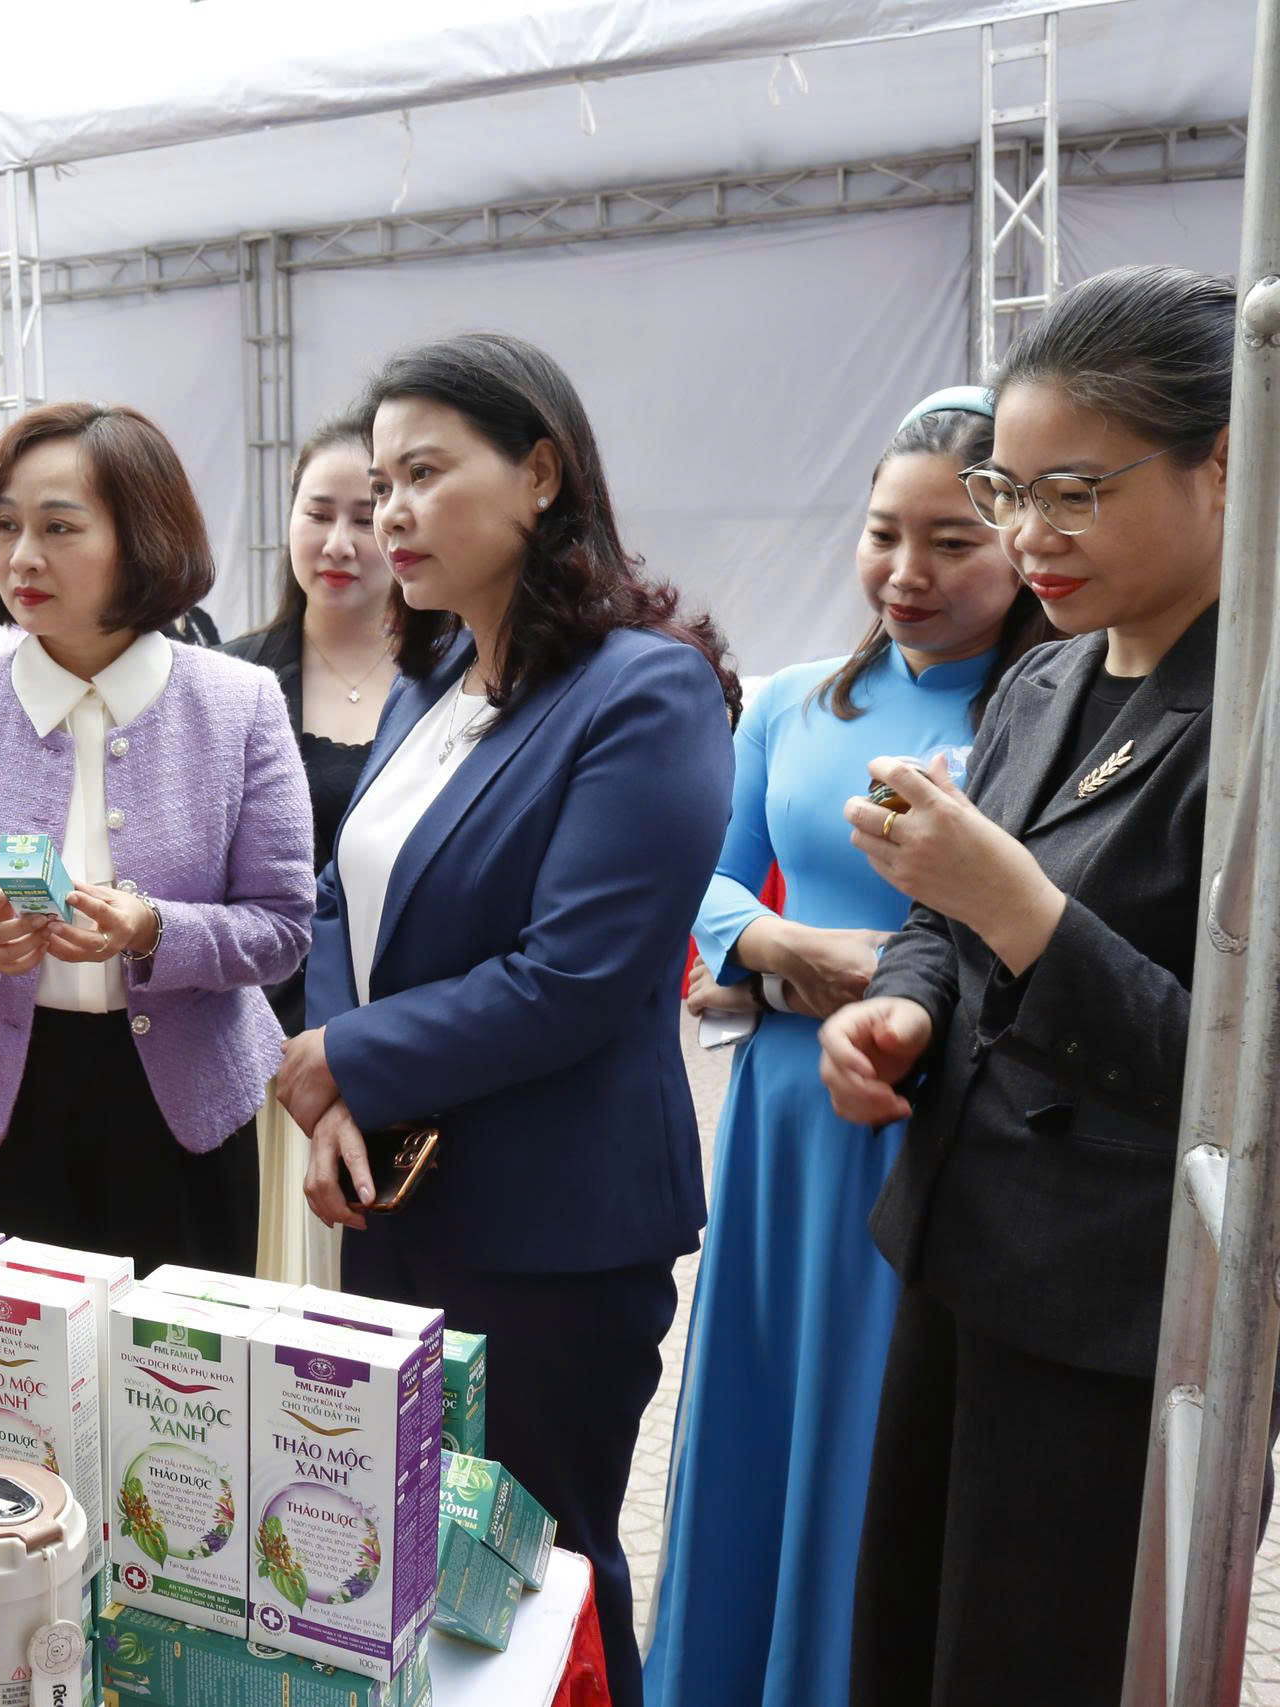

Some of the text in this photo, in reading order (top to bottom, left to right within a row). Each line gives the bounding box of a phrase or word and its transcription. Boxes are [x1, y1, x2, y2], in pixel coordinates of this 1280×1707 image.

[4, 1347, 16, 1356] EM
[24, 1343, 39, 1351] SINH
[154, 1345, 169, 1355] FML
[148, 1359, 169, 1370] DỊCH
[172, 1362, 188, 1375] RỬA
[191, 1368, 208, 1379] PHỤ
[211, 1372, 234, 1383] KHOA
[9, 1376, 47, 1397] MỘC
[295, 1381, 312, 1392] FML
[125, 1387, 232, 1427] THẢO MỘC
[282, 1391, 301, 1400] DUNG
[302, 1396, 319, 1405] DỊCH
[344, 1404, 361, 1412] SINH
[282, 1401, 360, 1424] CHO TUỔI DẬY THÌ
[150, 1415, 205, 1443] XANH
[8, 1432, 38, 1449] DƯỢC
[272, 1434, 372, 1471] THẢO MỘC
[149, 1466, 212, 1490] THẢO DƯỢC
[295, 1460, 347, 1485] XANH
[287, 1501, 358, 1528] THẢO DƯỢC
[194, 1591, 207, 1599] CHO
[213, 1614, 239, 1628] 100ml
[360, 1658, 382, 1672] 100ml
